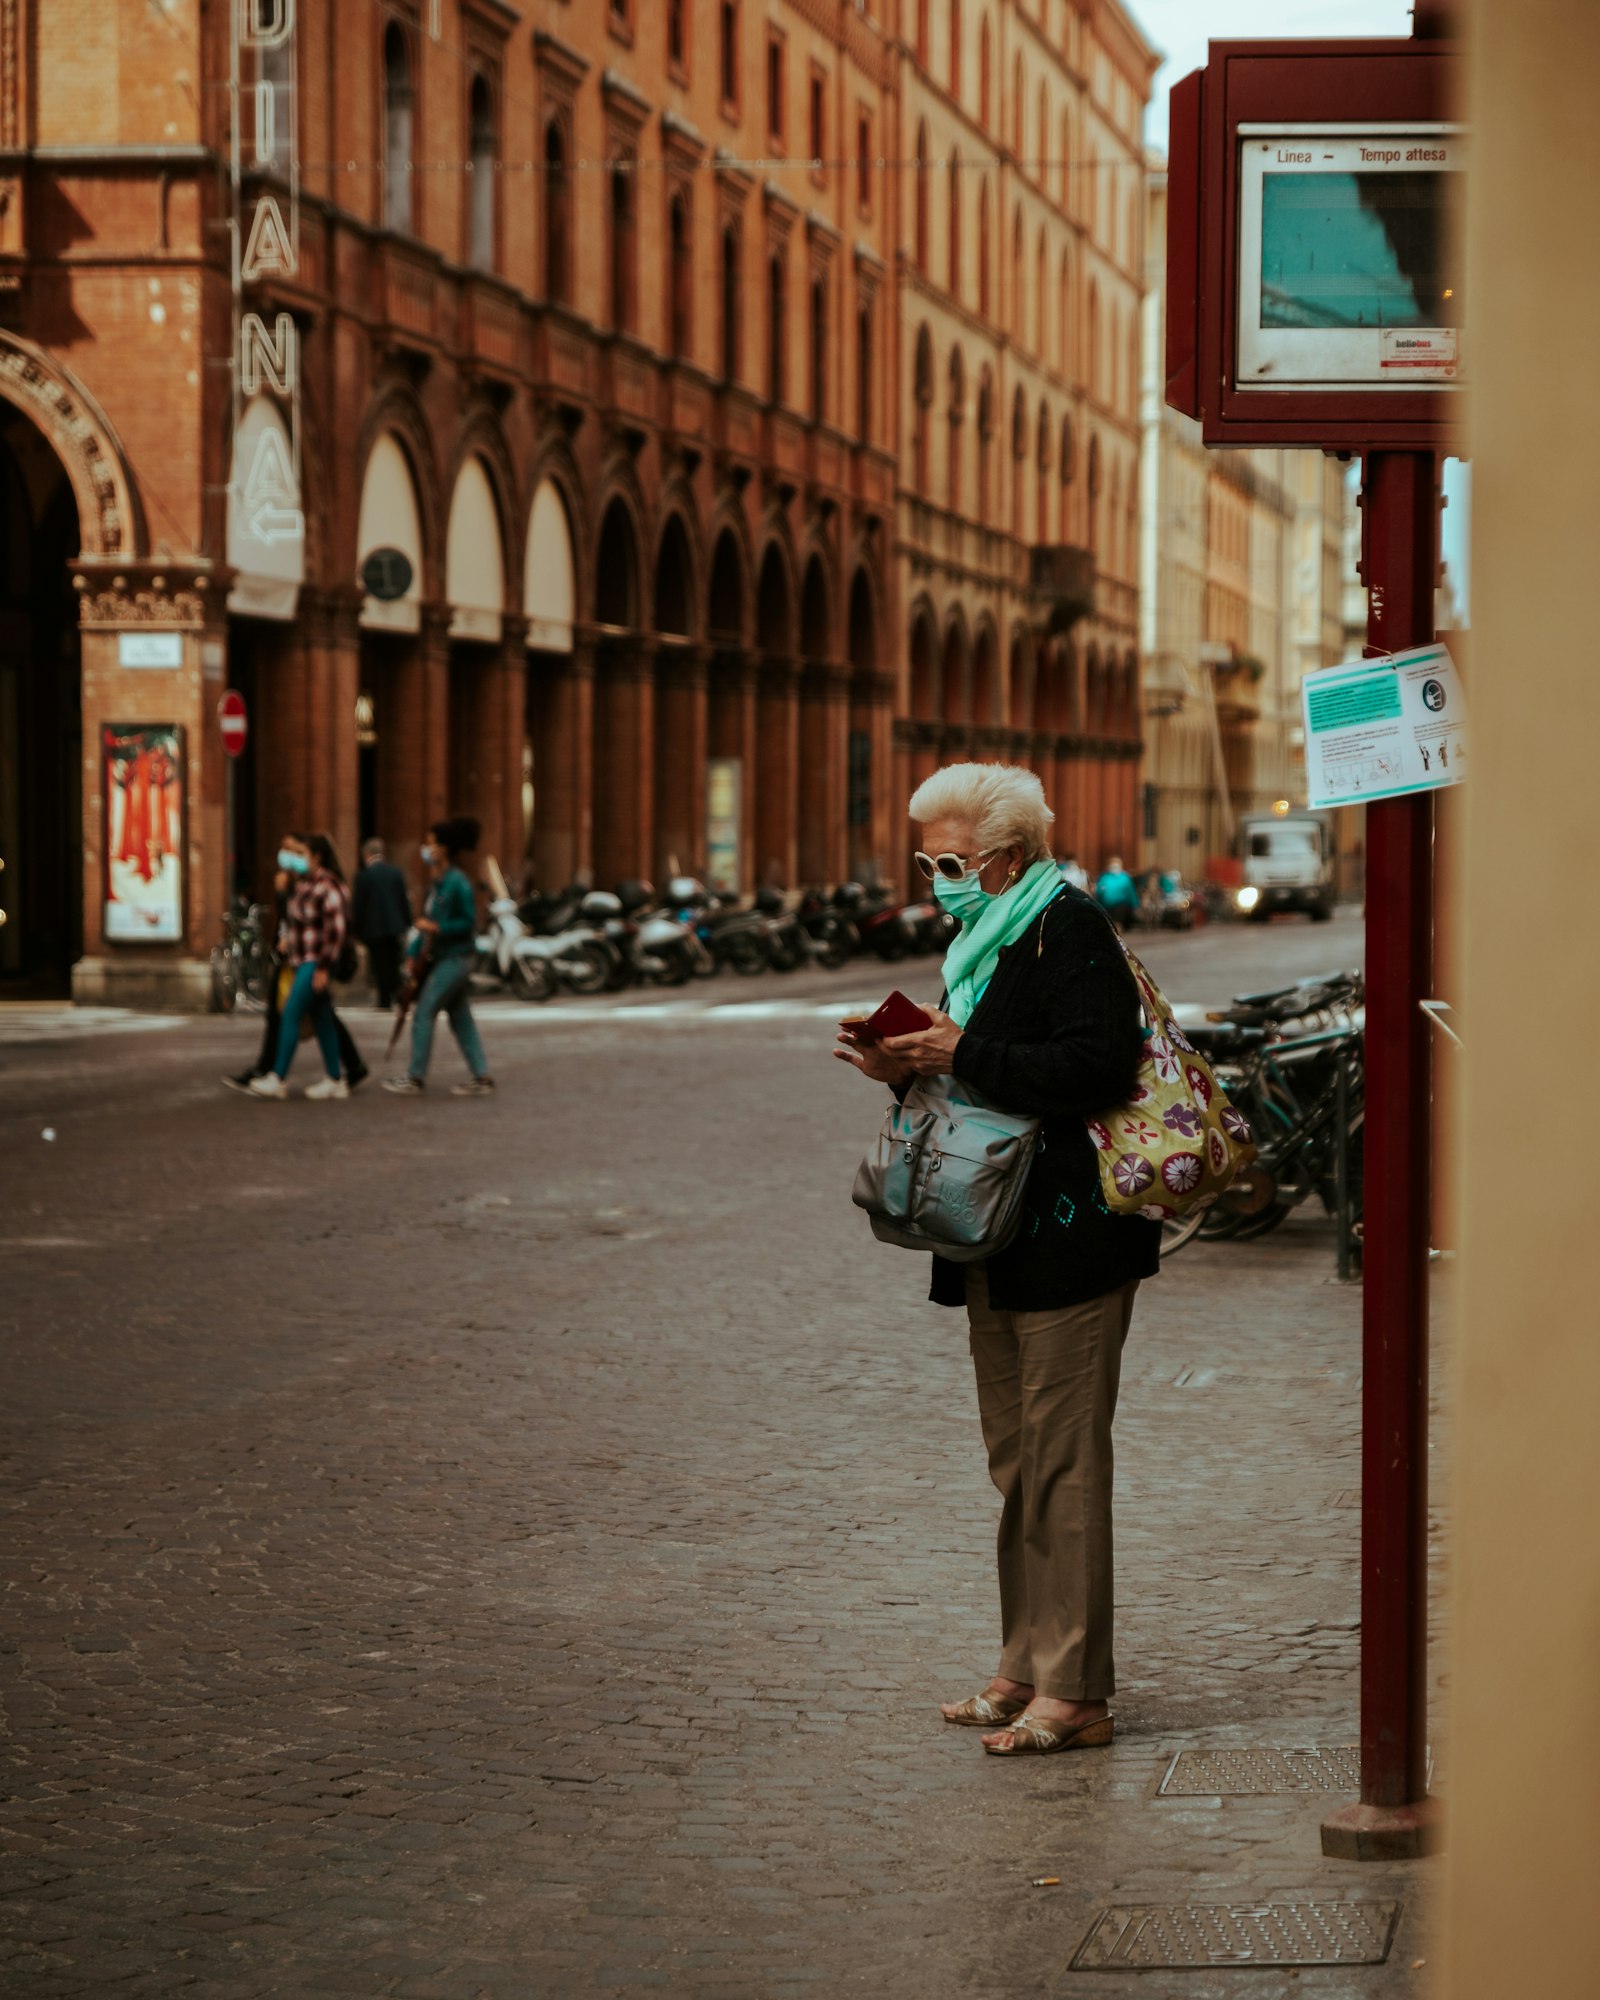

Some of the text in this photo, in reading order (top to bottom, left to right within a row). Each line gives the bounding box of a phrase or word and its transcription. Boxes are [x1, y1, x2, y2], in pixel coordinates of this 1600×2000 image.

[1277, 149, 1312, 163] Linea
[1360, 147, 1401, 165] Tempo
[1405, 147, 1446, 162] attesa
